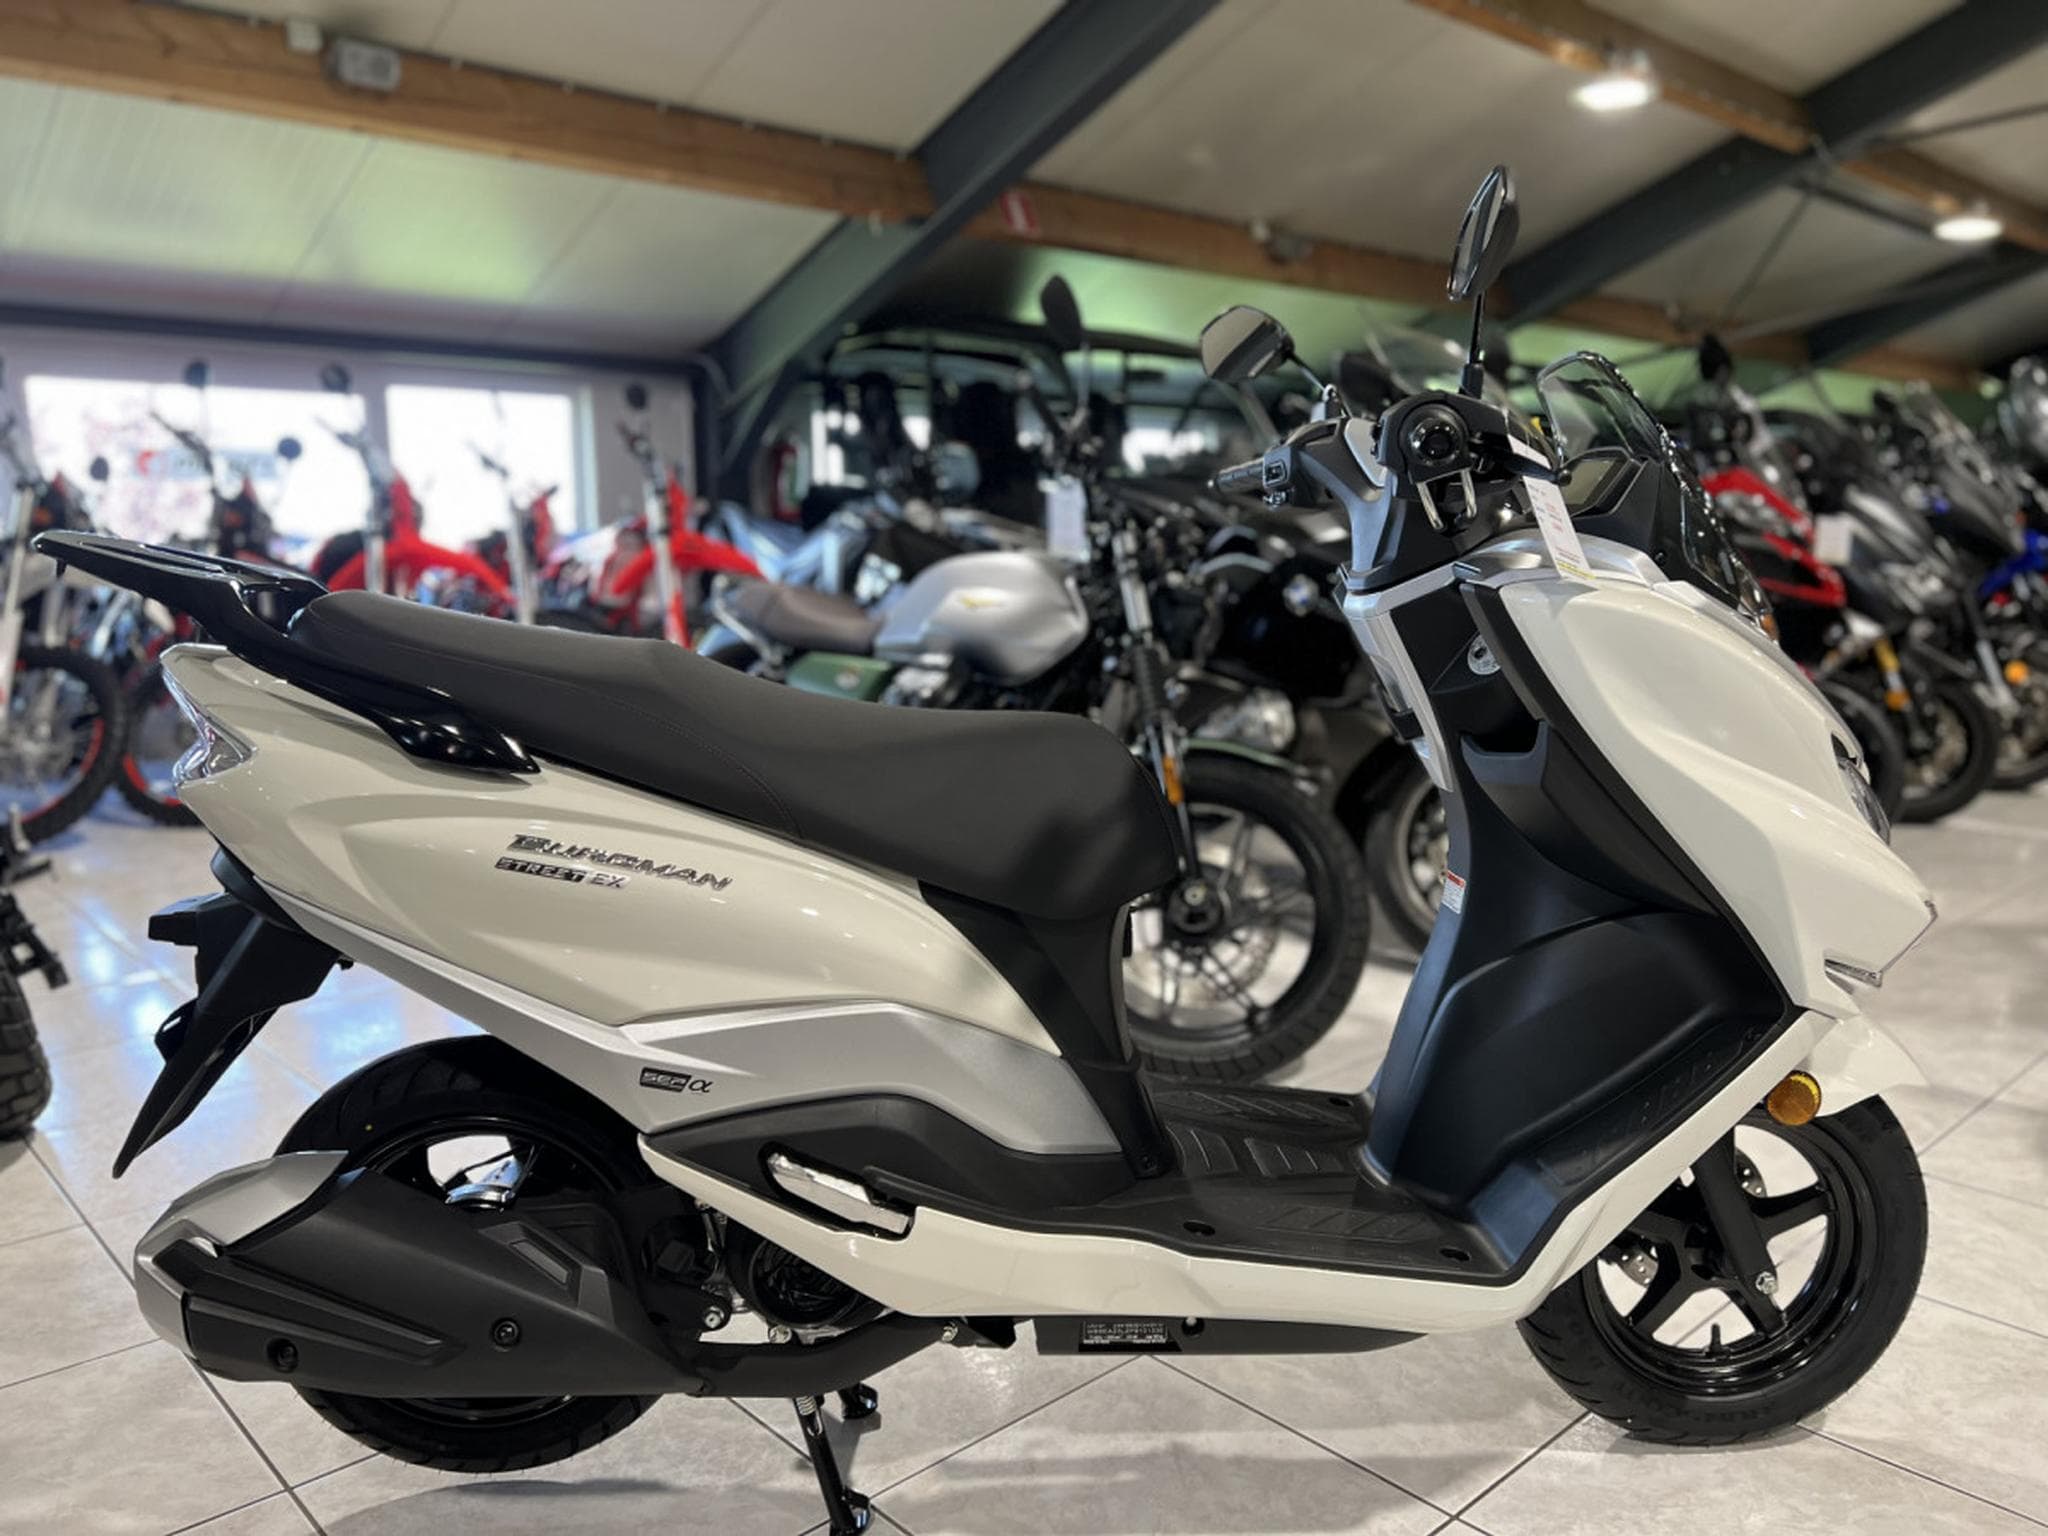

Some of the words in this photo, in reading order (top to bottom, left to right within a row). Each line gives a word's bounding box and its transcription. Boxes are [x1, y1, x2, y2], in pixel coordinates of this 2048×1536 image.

[496, 857, 586, 883] STREET
[588, 872, 626, 889] EX
[506, 833, 733, 891] BURGMAN
